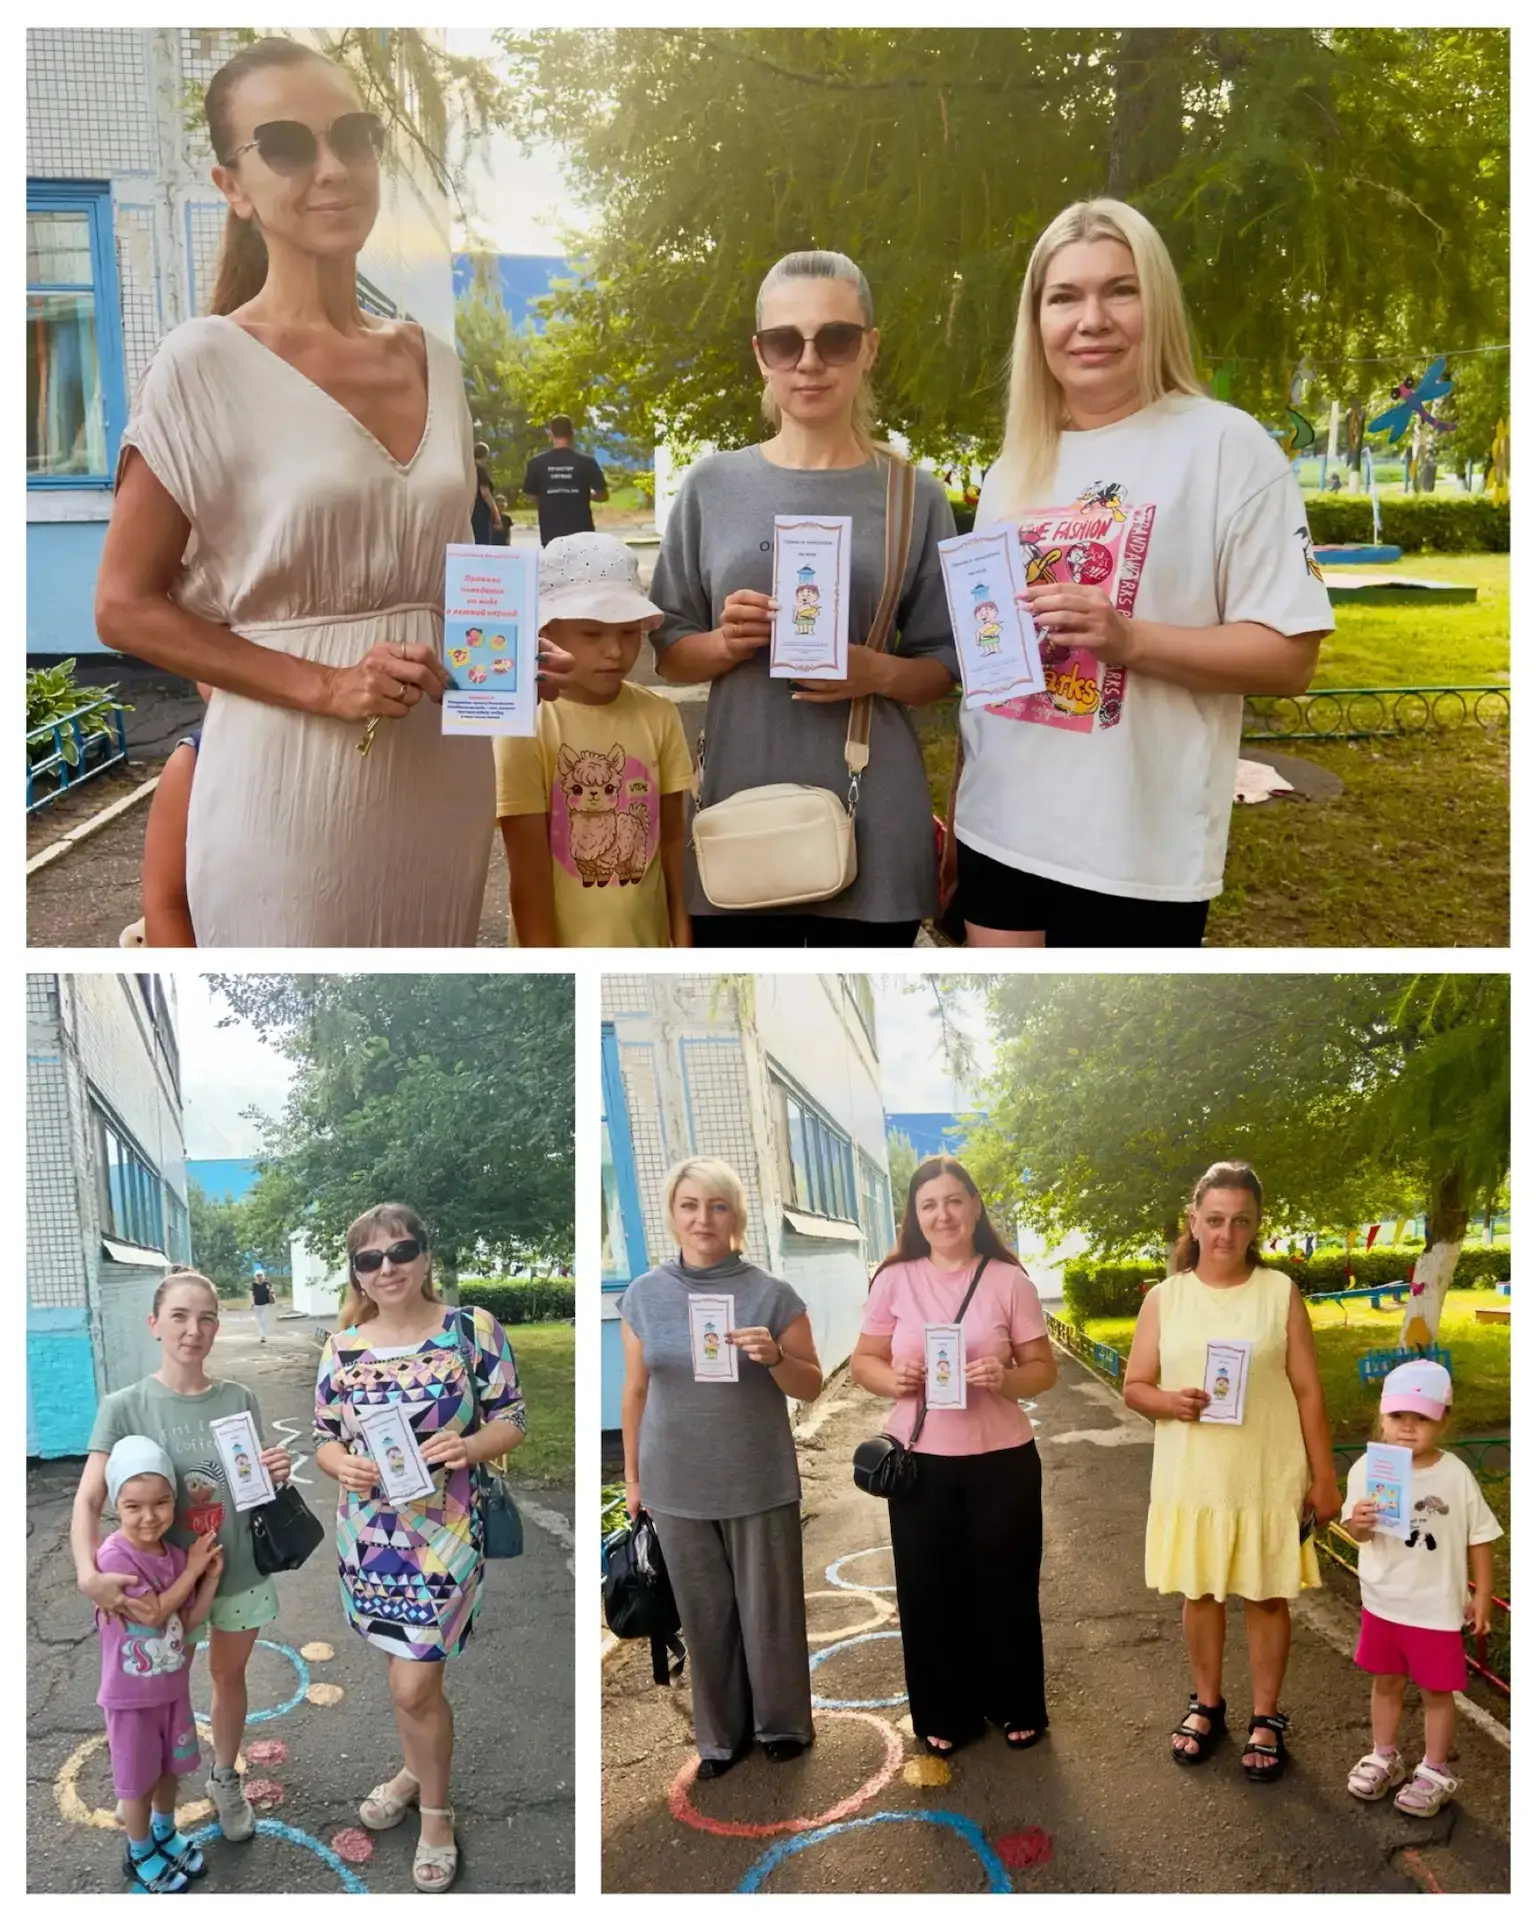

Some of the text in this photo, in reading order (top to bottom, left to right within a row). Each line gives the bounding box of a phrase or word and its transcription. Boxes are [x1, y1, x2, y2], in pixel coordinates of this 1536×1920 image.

[1052, 517, 1113, 541] FASHION
[760, 541, 774, 552] O
[1043, 662, 1097, 704] arks
[176, 1438, 216, 1454] coffe
